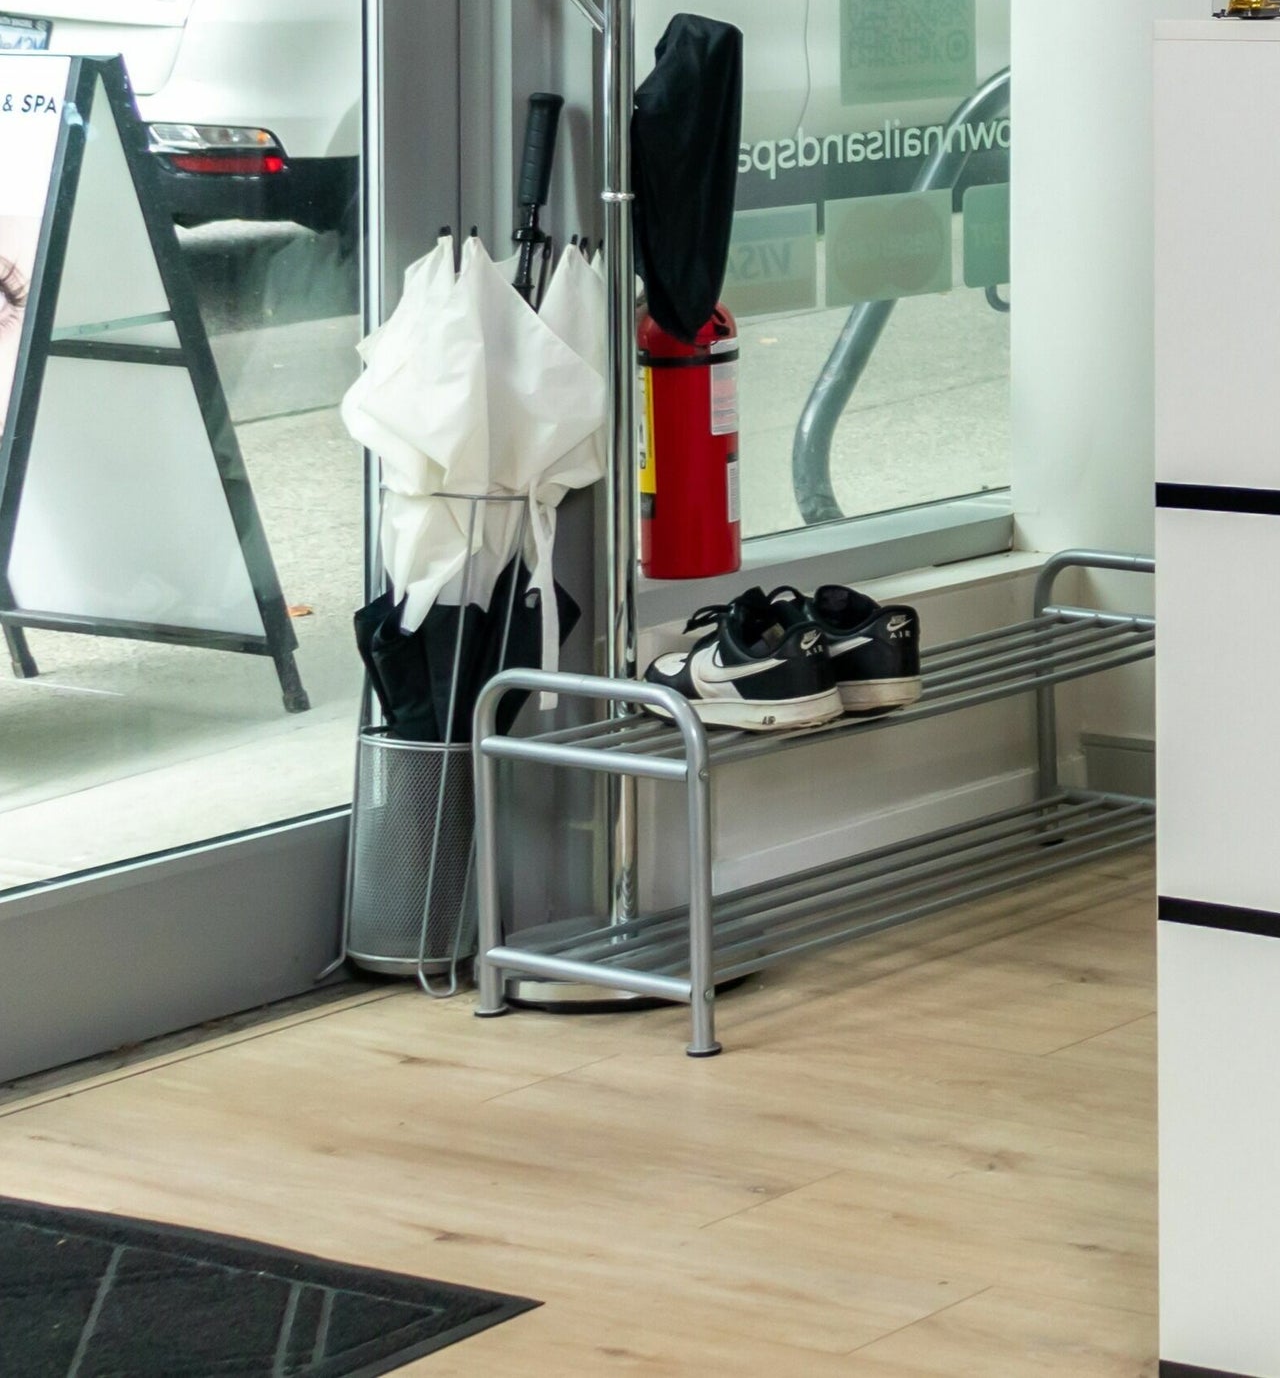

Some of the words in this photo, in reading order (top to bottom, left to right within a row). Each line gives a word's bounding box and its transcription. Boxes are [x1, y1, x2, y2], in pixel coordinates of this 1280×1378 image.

[2, 94, 13, 112] &
[21, 94, 57, 114] SPA
[889, 630, 912, 639] AIR
[805, 644, 824, 657] AIR
[761, 715, 776, 726] AIR
